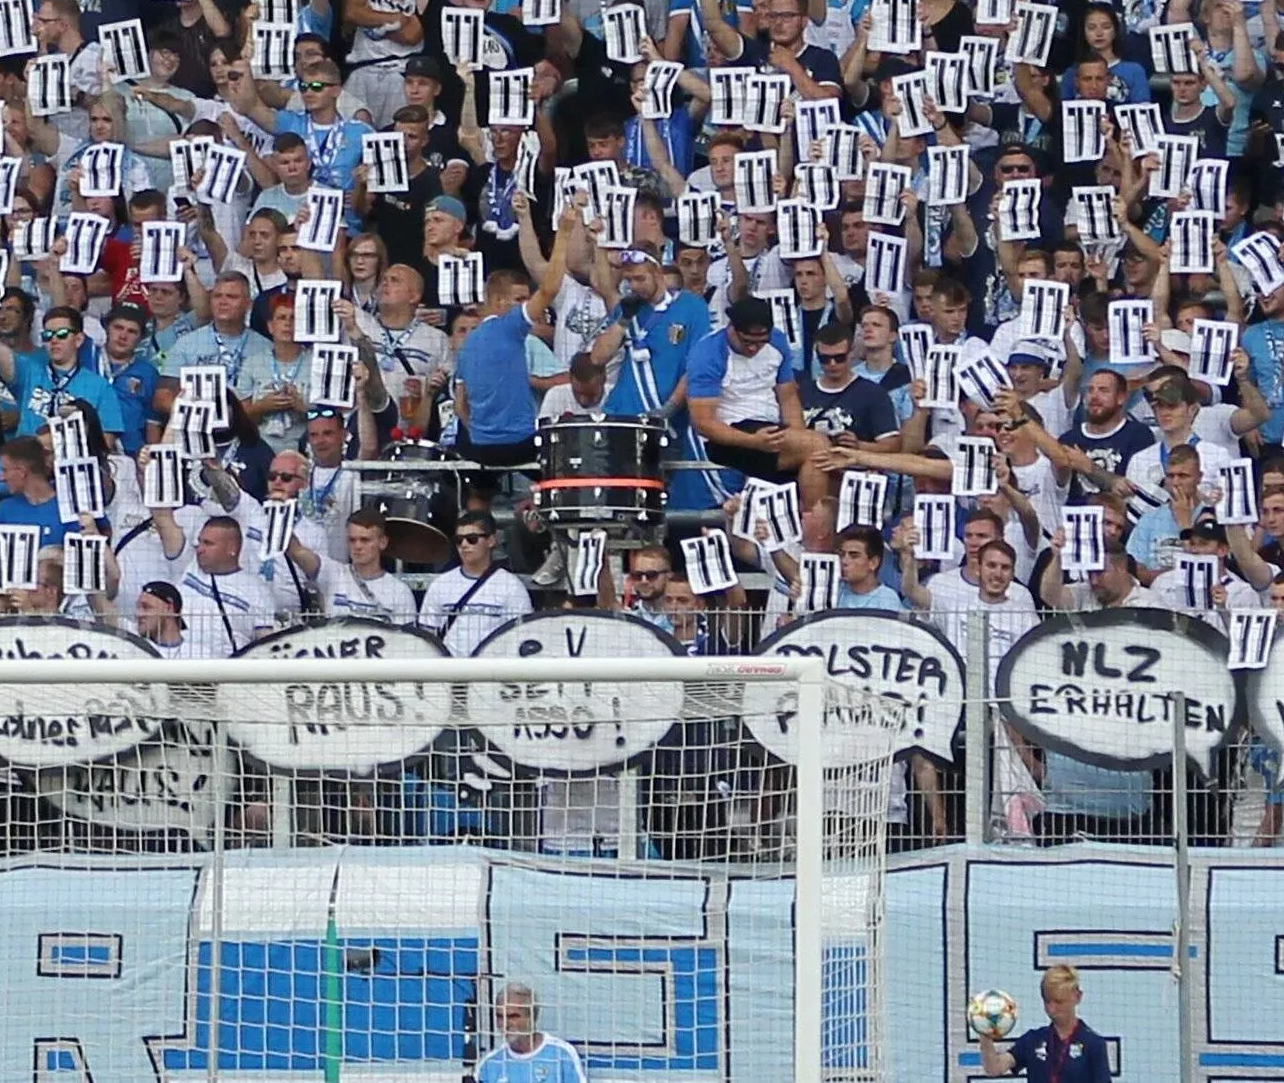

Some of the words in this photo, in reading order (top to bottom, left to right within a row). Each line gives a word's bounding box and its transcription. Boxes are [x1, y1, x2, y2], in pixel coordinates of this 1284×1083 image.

[257, 29, 291, 76] 11
[30, 60, 66, 109] 11
[366, 139, 403, 186] 11
[933, 150, 964, 200] 11
[1005, 186, 1036, 233] 11
[1175, 216, 1209, 267] 11
[1028, 286, 1067, 336] 11
[59, 462, 98, 516] 11
[145, 447, 179, 502] 11
[1066, 514, 1100, 563] 11
[69, 538, 101, 591] 11
[1061, 641, 1161, 683] NLZ
[1030, 684, 1227, 734] ERHALTEN
